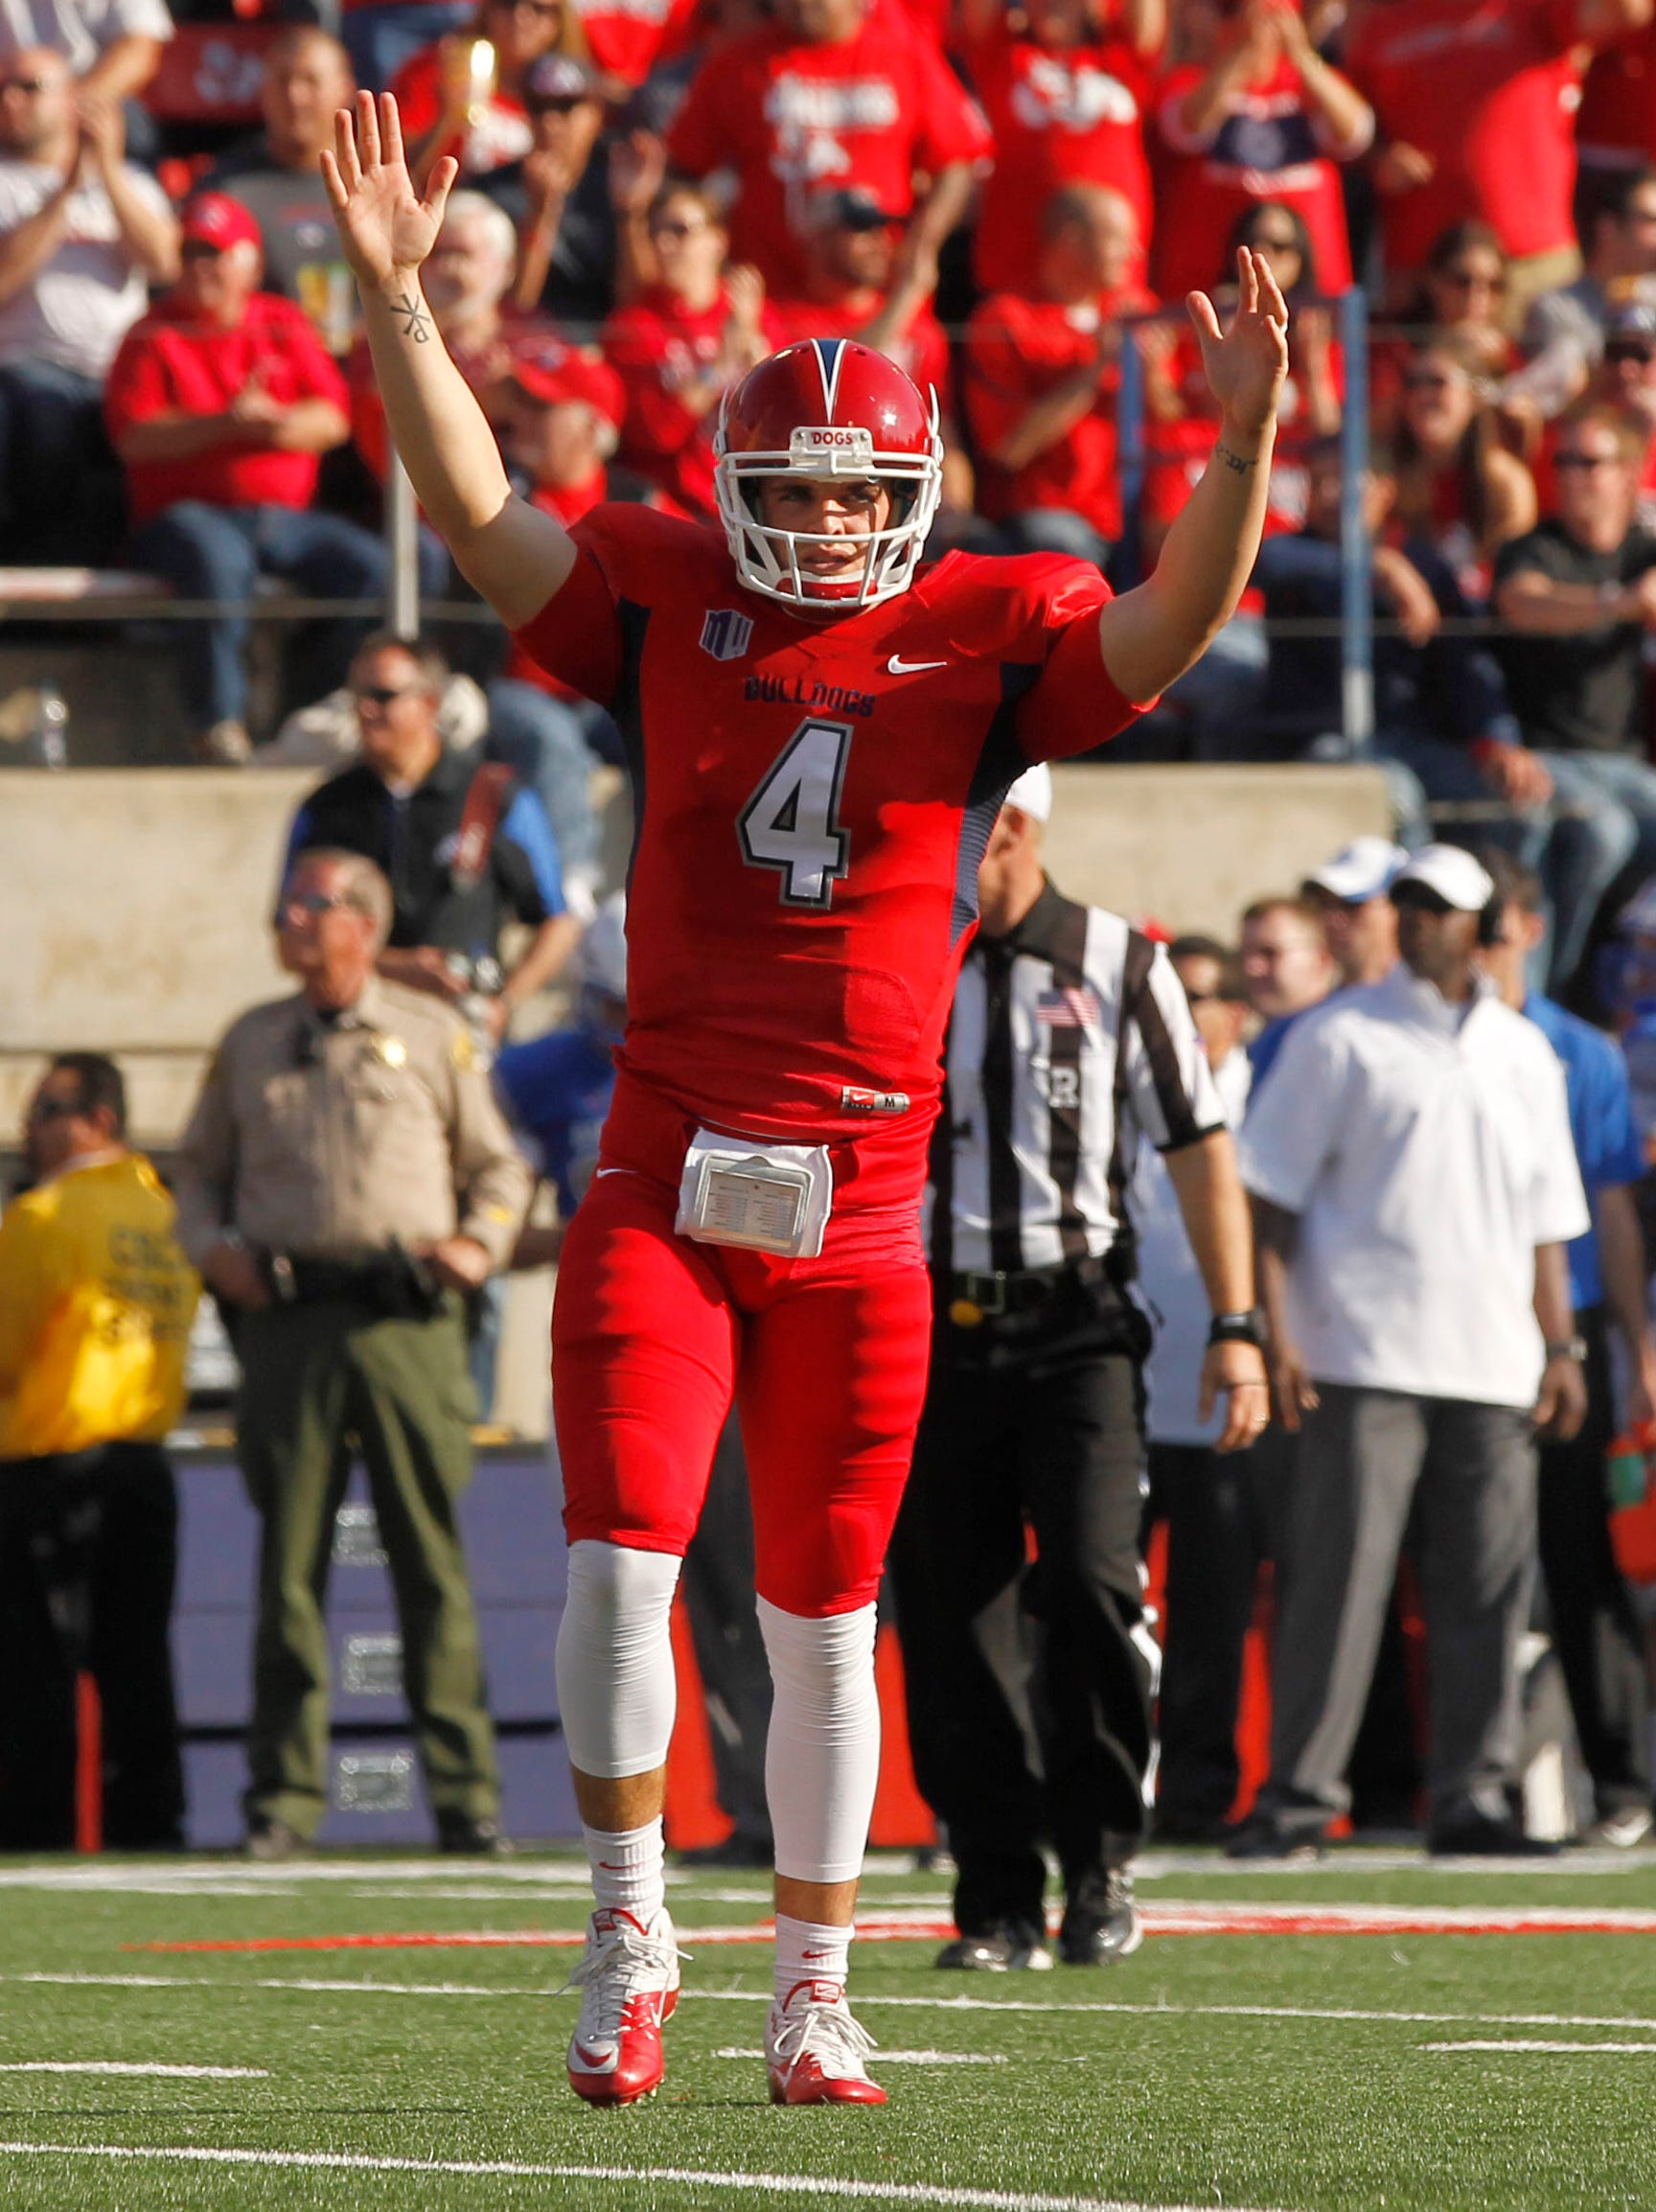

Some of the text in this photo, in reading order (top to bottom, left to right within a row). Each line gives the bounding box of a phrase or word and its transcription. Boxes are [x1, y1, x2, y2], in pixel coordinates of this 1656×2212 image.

[813, 431, 853, 445] DOGS
[745, 676, 876, 717] BULLDOGS
[734, 717, 854, 910] 4
[885, 1095, 895, 1108] M
[1049, 1065, 1081, 1109] R
